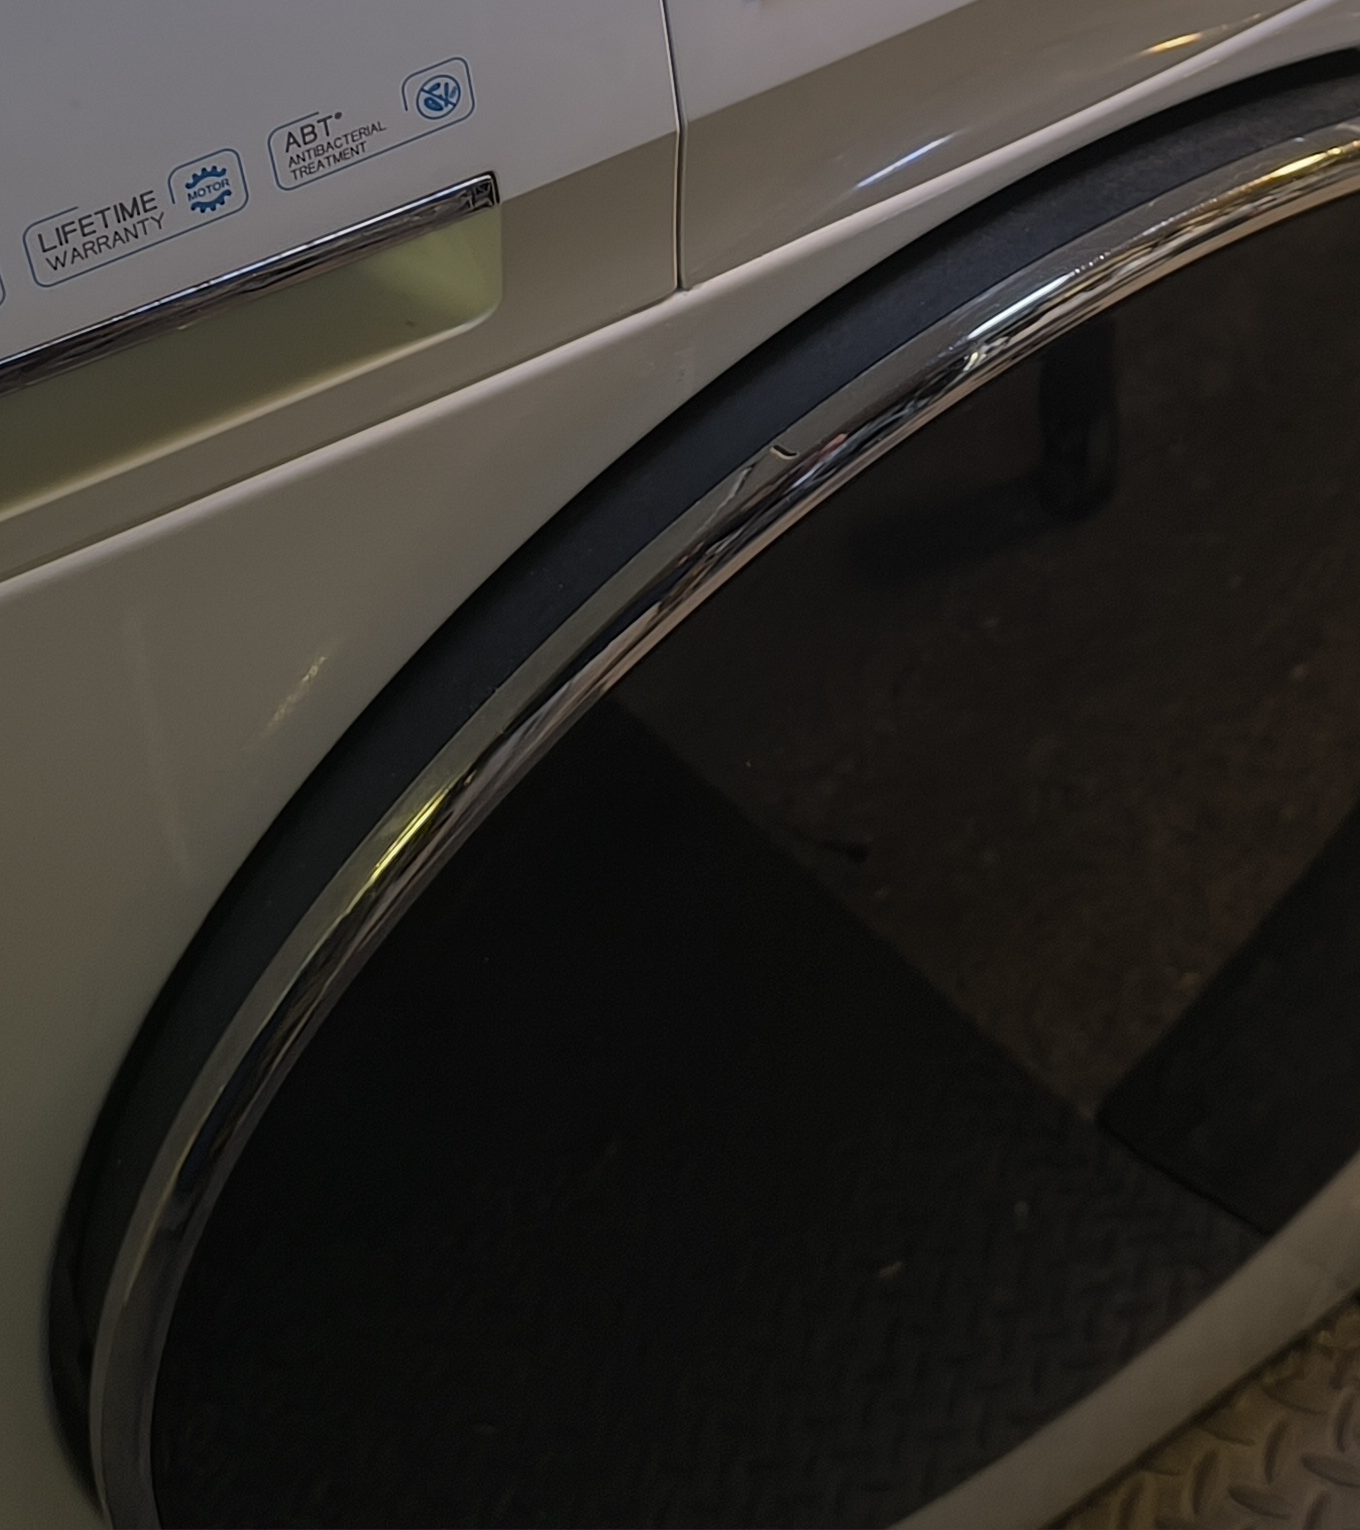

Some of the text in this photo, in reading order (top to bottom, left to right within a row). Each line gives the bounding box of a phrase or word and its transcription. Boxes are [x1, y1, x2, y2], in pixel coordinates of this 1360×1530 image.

[288, 121, 386, 167] ANTIBACTERIAL
[290, 142, 367, 181] TREATMENT
[188, 178, 230, 201] MOTOR
[38, 190, 158, 253] LIFETIME
[45, 213, 165, 270] WARRANTY
